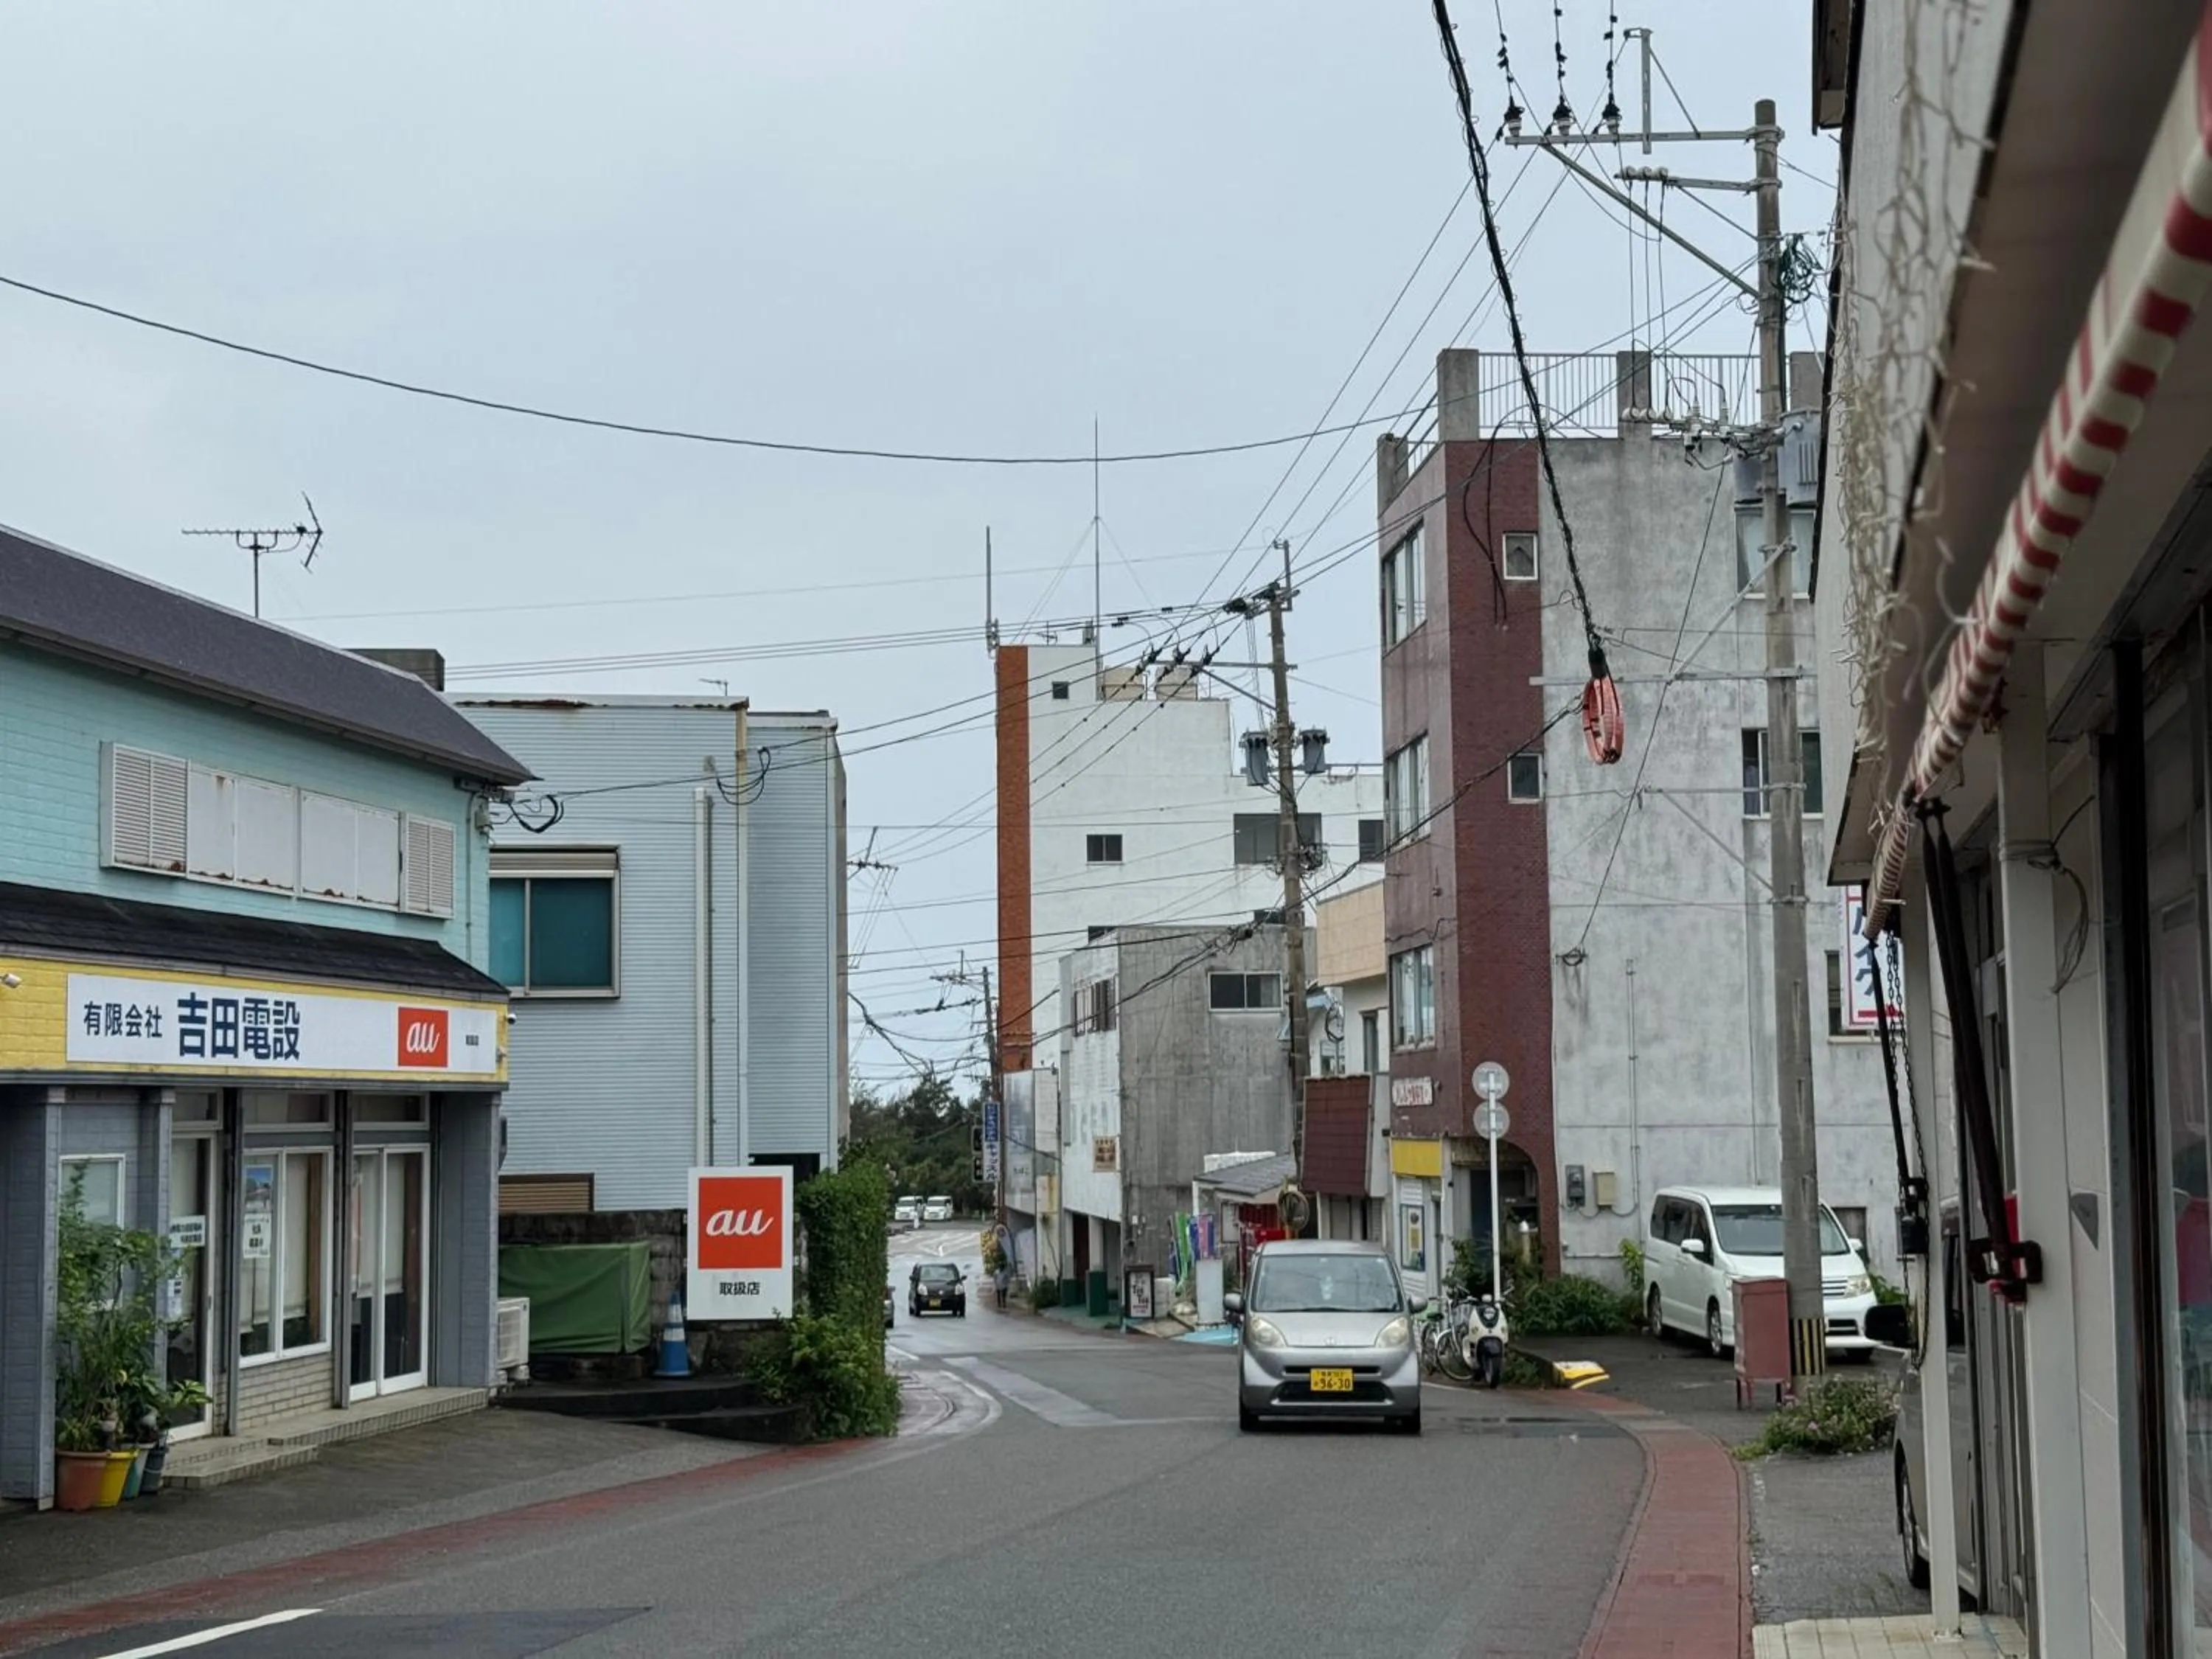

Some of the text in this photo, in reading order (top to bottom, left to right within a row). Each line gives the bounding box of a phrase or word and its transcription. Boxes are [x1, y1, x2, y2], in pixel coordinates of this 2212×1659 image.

[83, 992, 300, 1060] 有限会社 吉田電設
[406, 1022, 440, 1053] au
[706, 1208, 773, 1237] au
[719, 1281, 760, 1295] 取扱店
